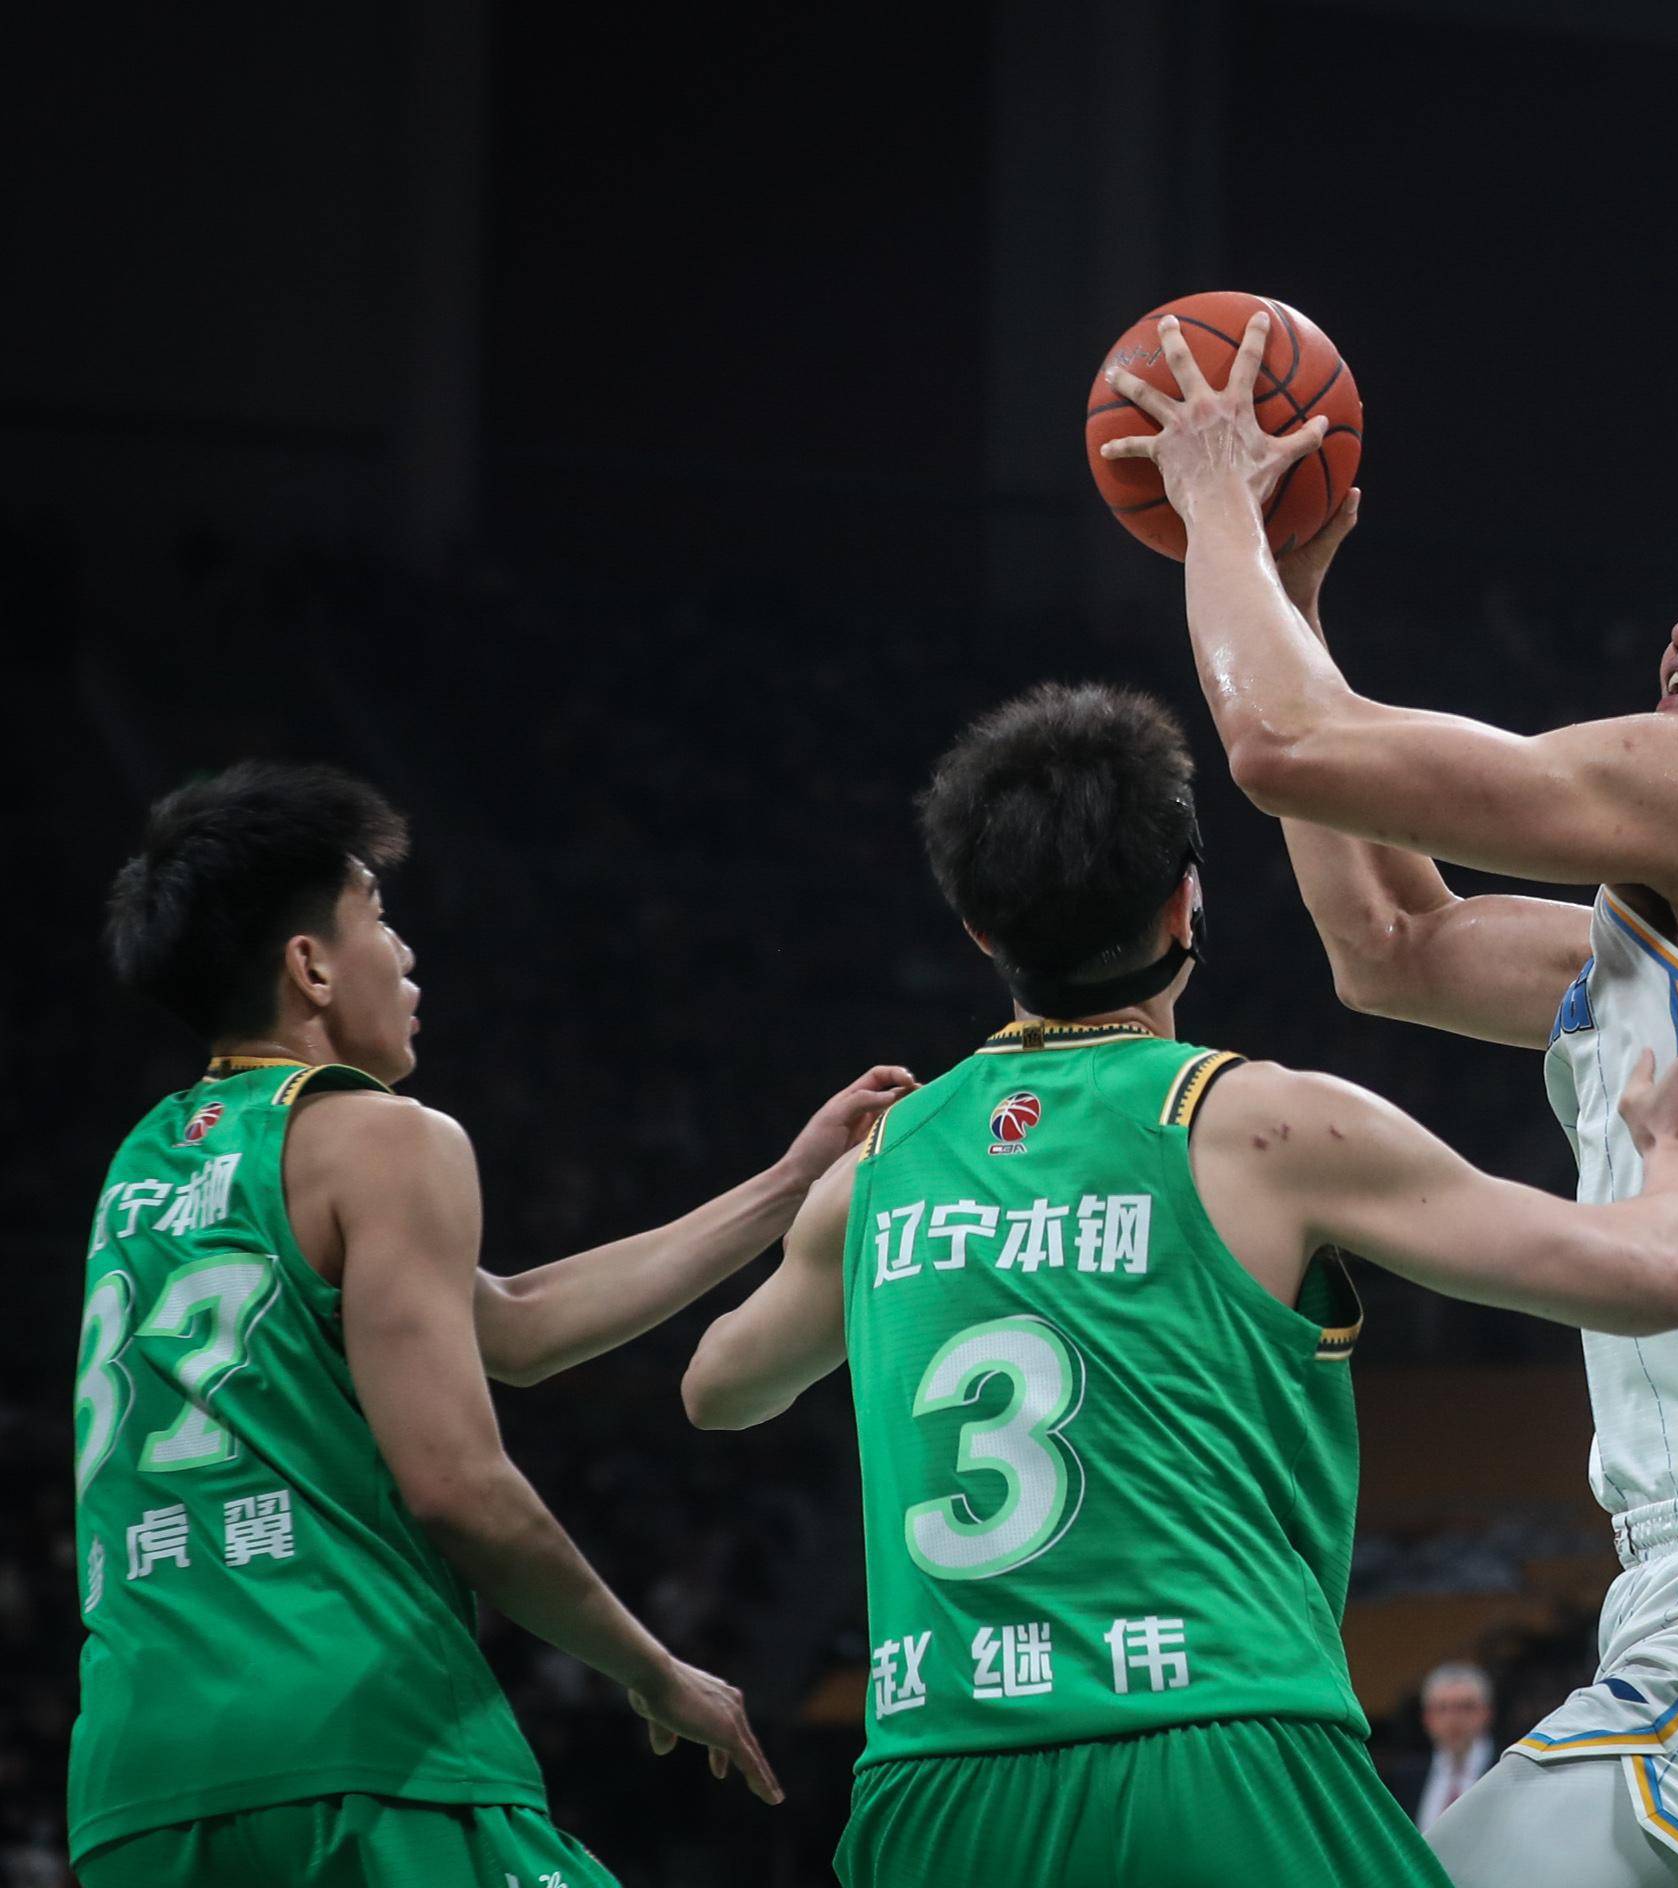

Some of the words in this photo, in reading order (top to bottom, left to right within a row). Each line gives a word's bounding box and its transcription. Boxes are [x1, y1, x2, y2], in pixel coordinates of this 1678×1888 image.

[872, 1194, 1152, 1288] 辽宁本钢
[904, 1313, 1087, 1581] 3
[84, 1489, 295, 1615] 虎翼
[870, 1615, 1190, 1720] 赵继伟
